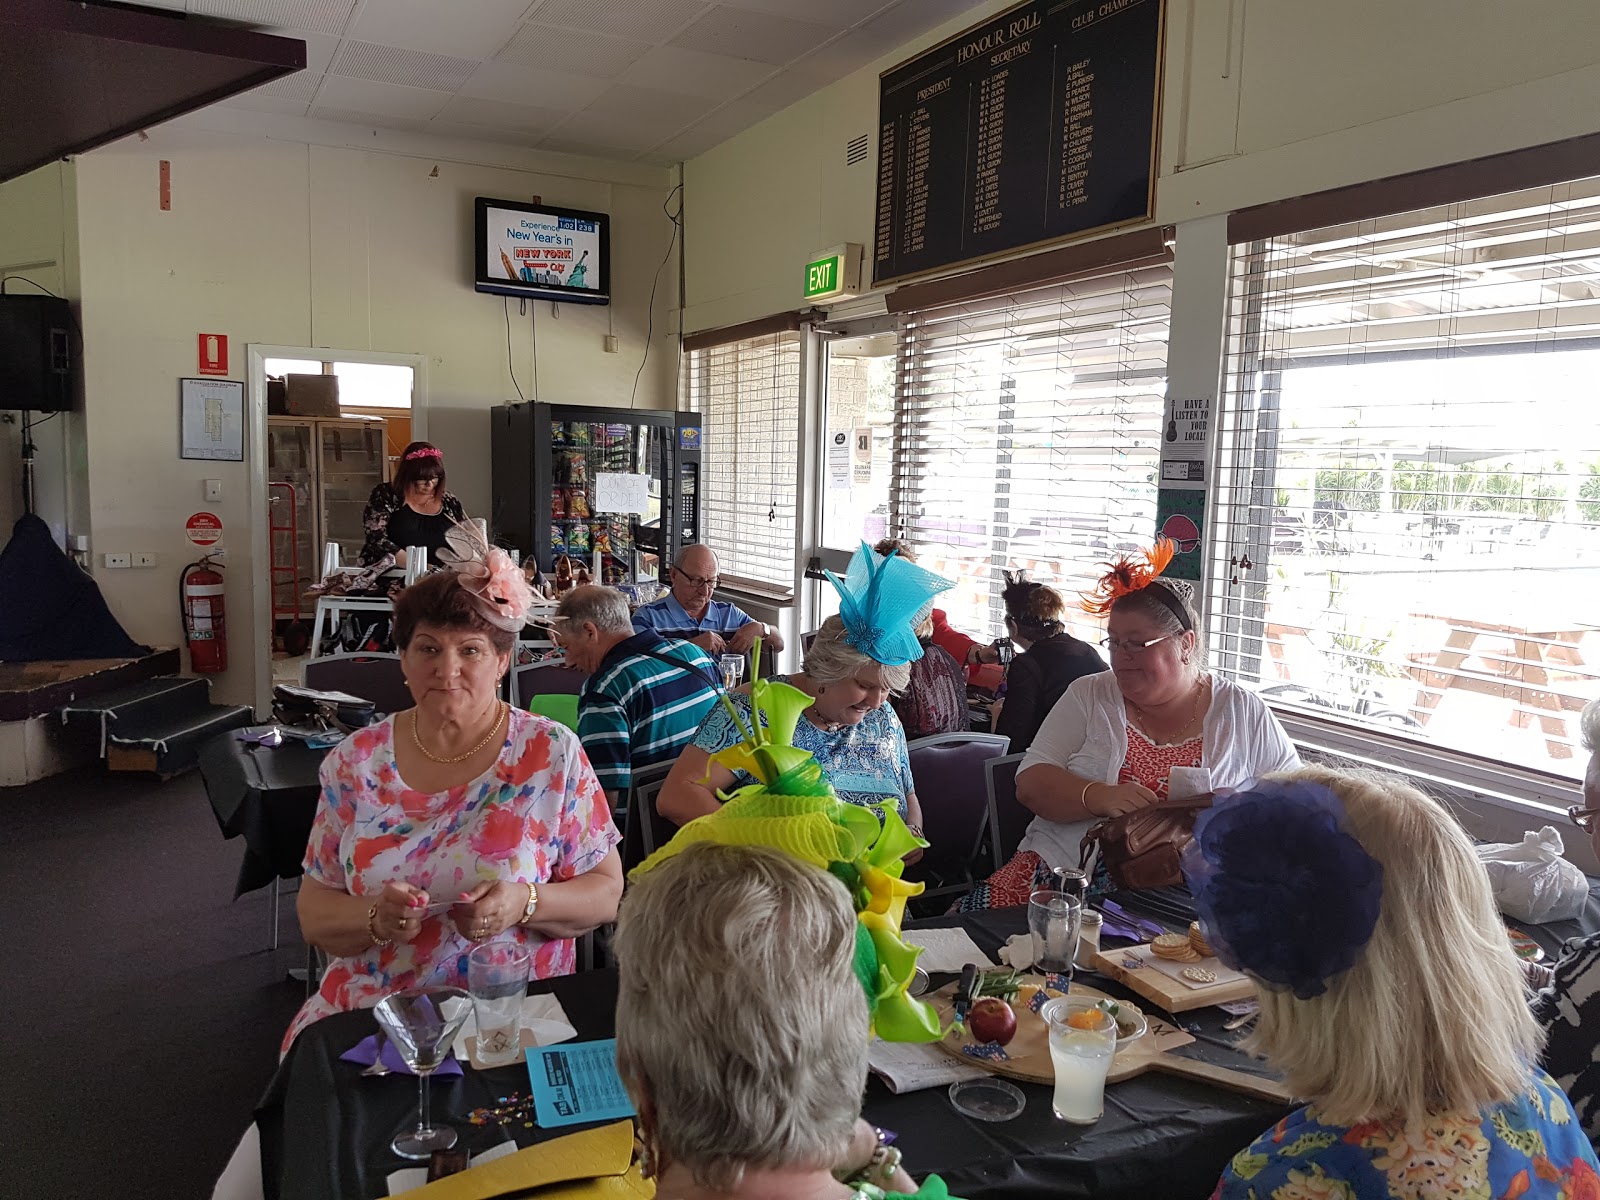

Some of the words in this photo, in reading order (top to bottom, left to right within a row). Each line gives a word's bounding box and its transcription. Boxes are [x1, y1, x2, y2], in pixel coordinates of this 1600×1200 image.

[1072, 10, 1094, 28] CLUB
[958, 28, 1004, 62] HONOUR
[1009, 12, 1041, 38] ROLL
[990, 39, 1032, 66] SECRETARY
[1073, 59, 1090, 71] BAILEY
[917, 77, 952, 100] PRESIDENT
[521, 220, 559, 232] Experience
[507, 228, 530, 240] New
[532, 230, 562, 244] Year's
[564, 234, 574, 246] in
[516, 249, 540, 258] NEW
[543, 250, 571, 259] YORK
[810, 262, 832, 292] EXIT
[1184, 400, 1202, 409] HAVE
[1204, 399, 1209, 408] A
[1176, 410, 1198, 420] LISTEN
[1201, 410, 1208, 419] TO
[1191, 421, 1207, 430] YOUR
[1184, 432, 1206, 441] LOCAL!
[599, 491, 644, 507] ORDER
